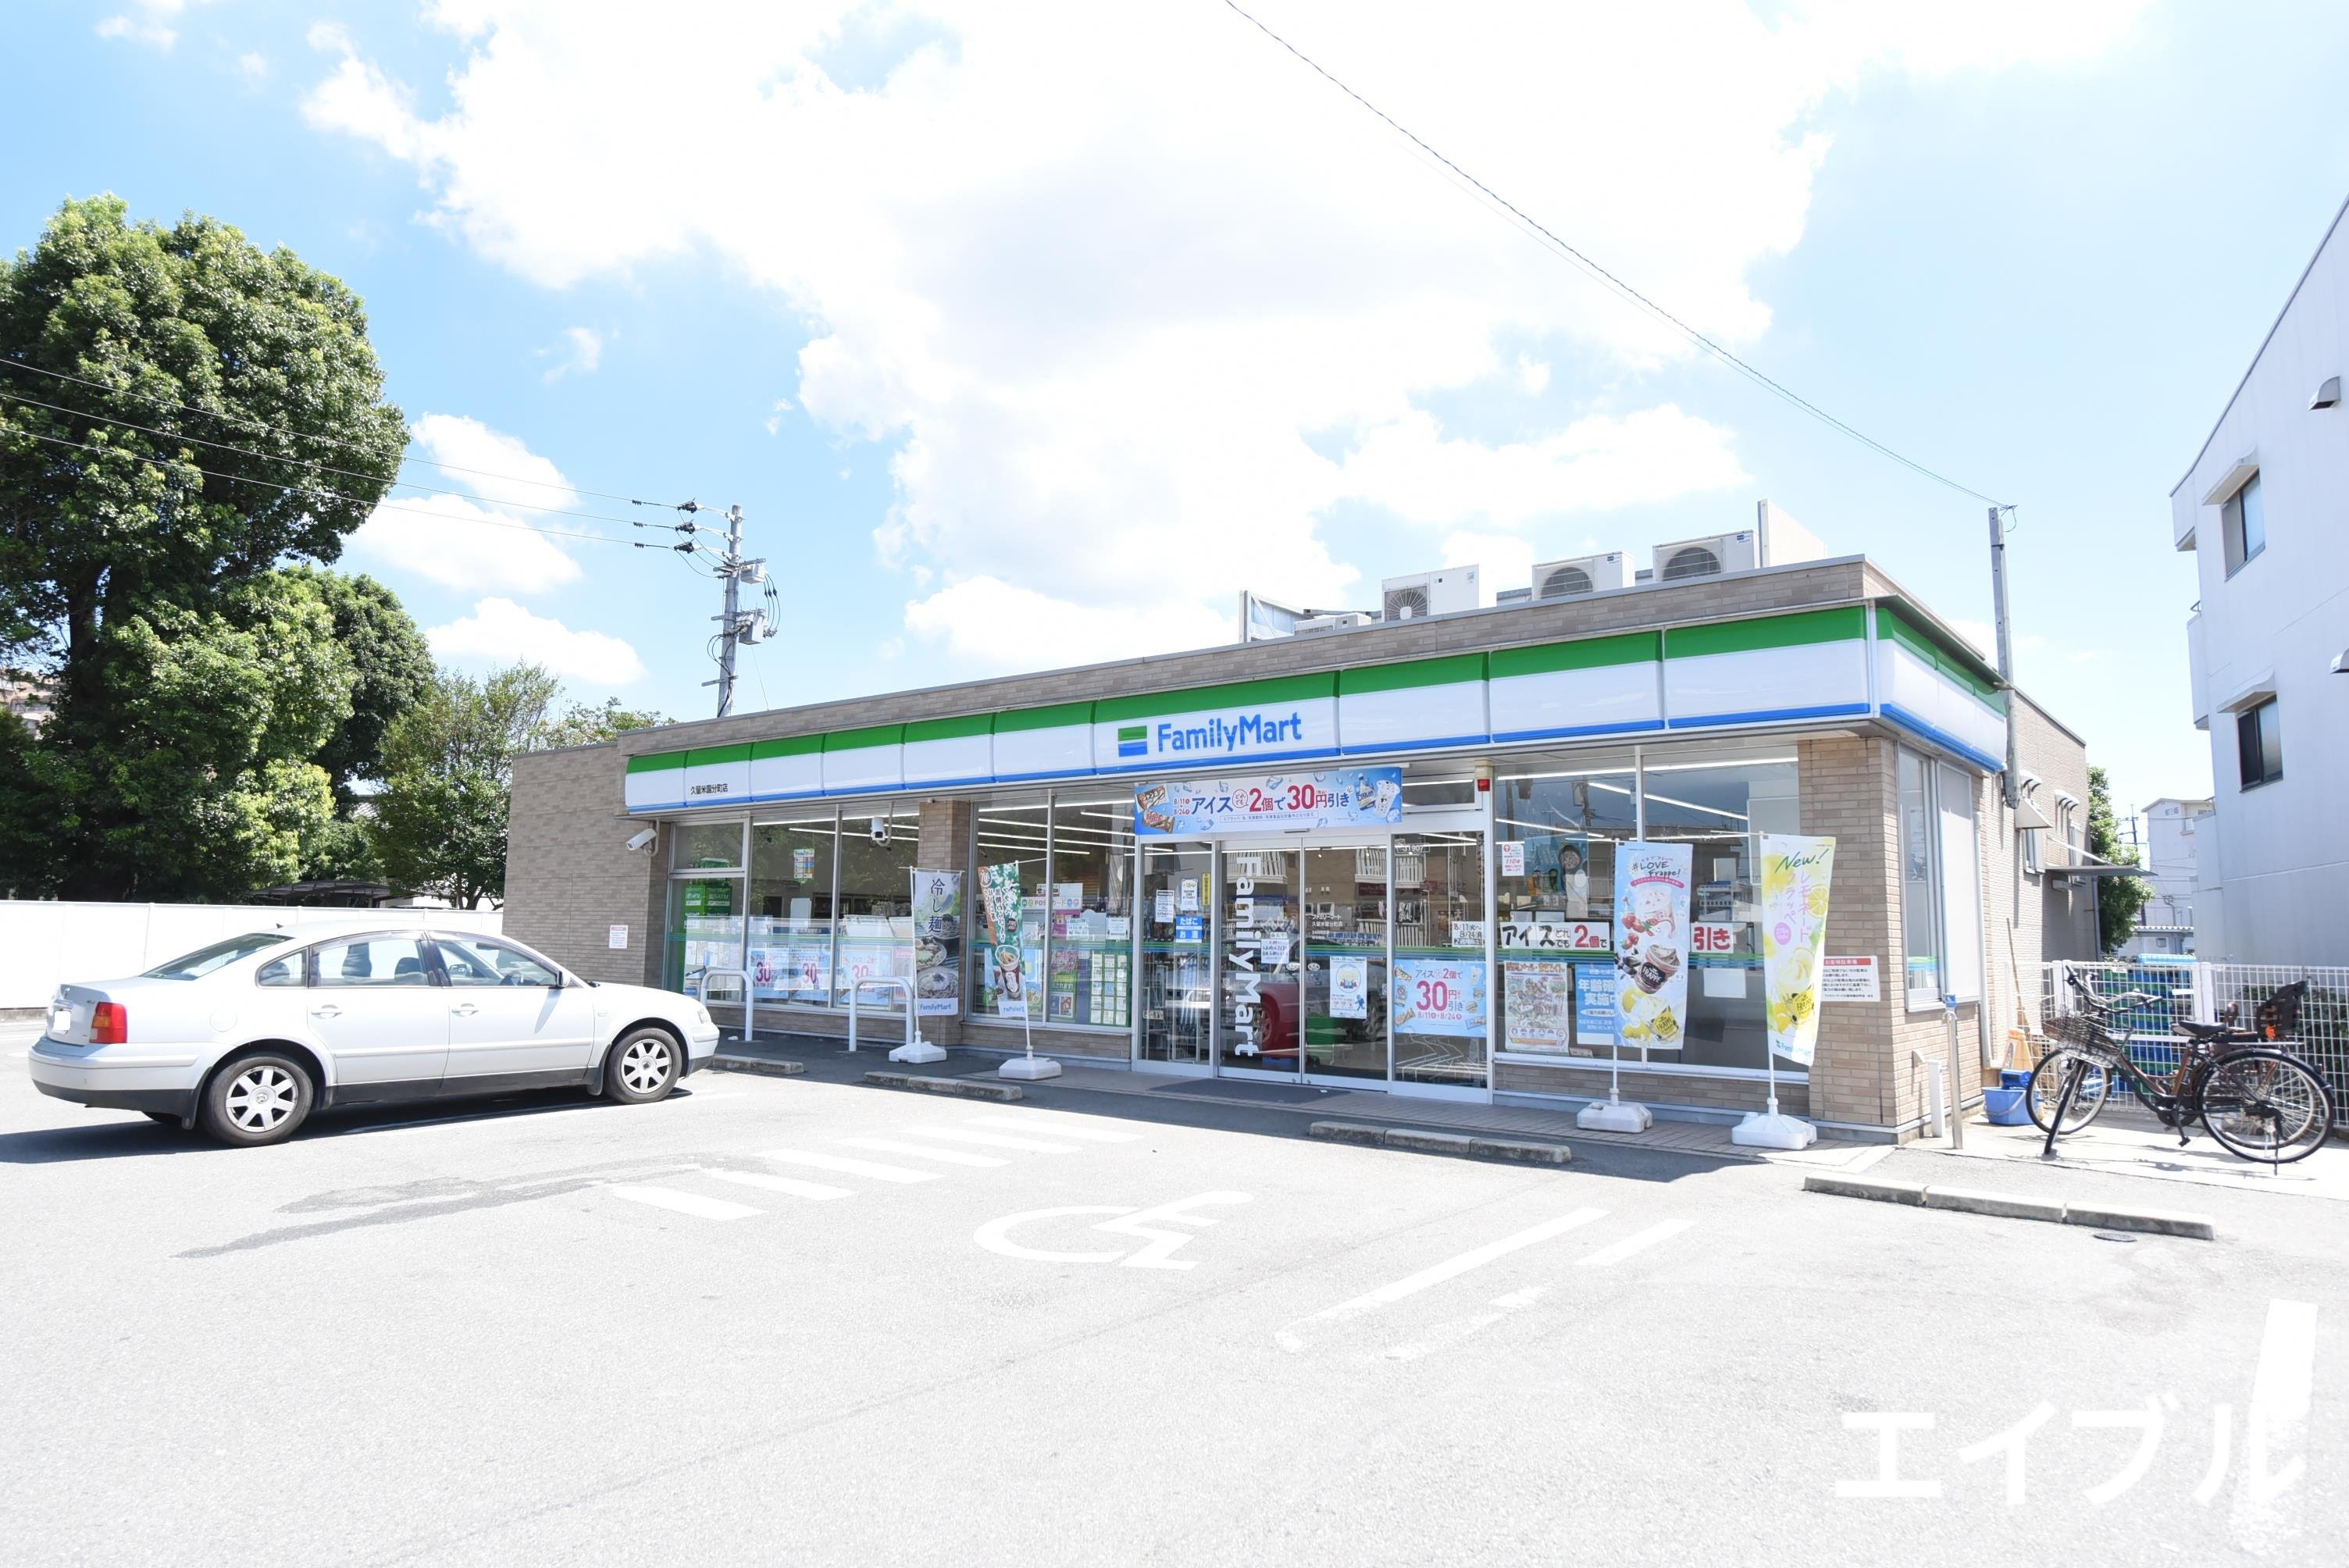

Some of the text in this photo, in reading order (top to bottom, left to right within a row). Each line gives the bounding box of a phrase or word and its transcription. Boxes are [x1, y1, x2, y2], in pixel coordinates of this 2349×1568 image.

[1158, 712, 1302, 752] FamilyMart
[690, 783, 728, 795] 久留米国分町店
[1631, 861, 1669, 872] #LOVE
[1775, 849, 1829, 873] New!
[1649, 869, 1681, 880] Frappe!
[928, 878, 946, 934] 冷し麺
[1784, 873, 1797, 925] フラッペ
[1798, 871, 1813, 943] レモネード
[1502, 925, 1555, 947] アイス
[1574, 924, 1607, 948] 2個で
[1693, 926, 1731, 950] 引き
[1229, 857, 1262, 1057] FamilyMart
[756, 961, 771, 982] 30
[802, 963, 817, 984] 30
[1415, 969, 1435, 979] アイス
[1642, 967, 1663, 983] FRAPPE
[1577, 979, 1614, 992] 年齢確
[920, 1002, 951, 1010] FamilyMart
[1656, 1017, 1674, 1032] FRAPPE
